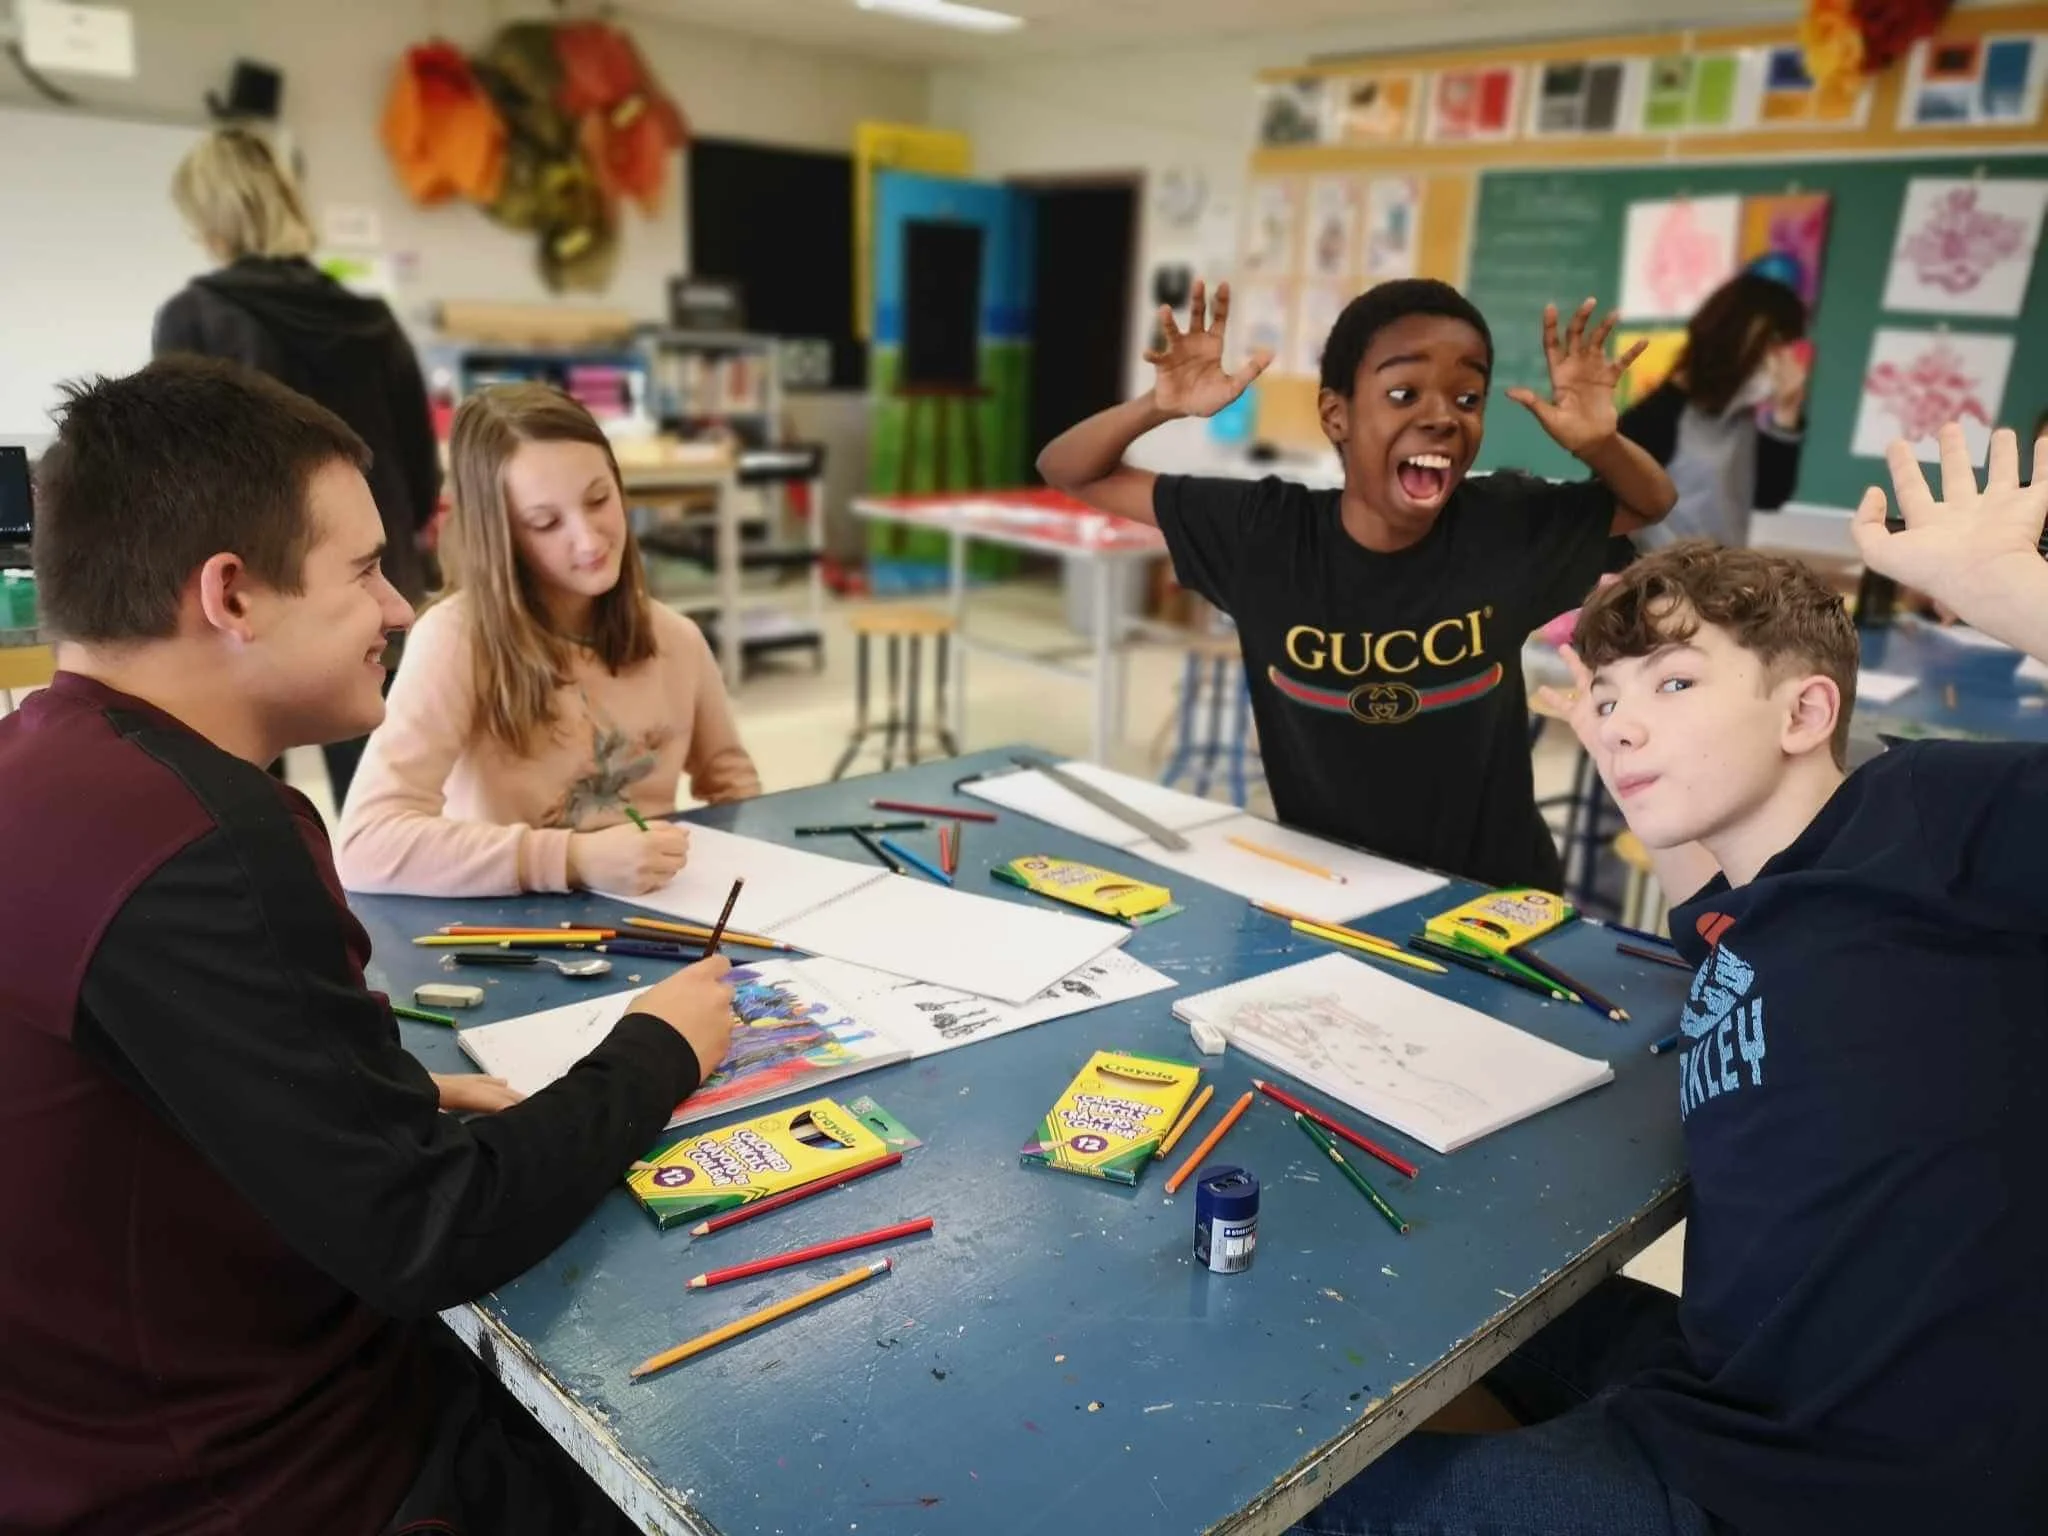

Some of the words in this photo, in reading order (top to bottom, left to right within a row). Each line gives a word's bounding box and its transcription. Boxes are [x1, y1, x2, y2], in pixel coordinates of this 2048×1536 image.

[1285, 610, 1482, 676] GUCCI
[1104, 1063, 1174, 1080] Crayola
[1072, 1094, 1163, 1114] COLOURED
[1078, 1101, 1147, 1121] PENCILS
[812, 1110, 858, 1144] Crayola
[733, 1129, 791, 1172] COLOURED
[1077, 1137, 1101, 1150] 12
[723, 1136, 769, 1172] PENCILS
[661, 1169, 686, 1185] 12
